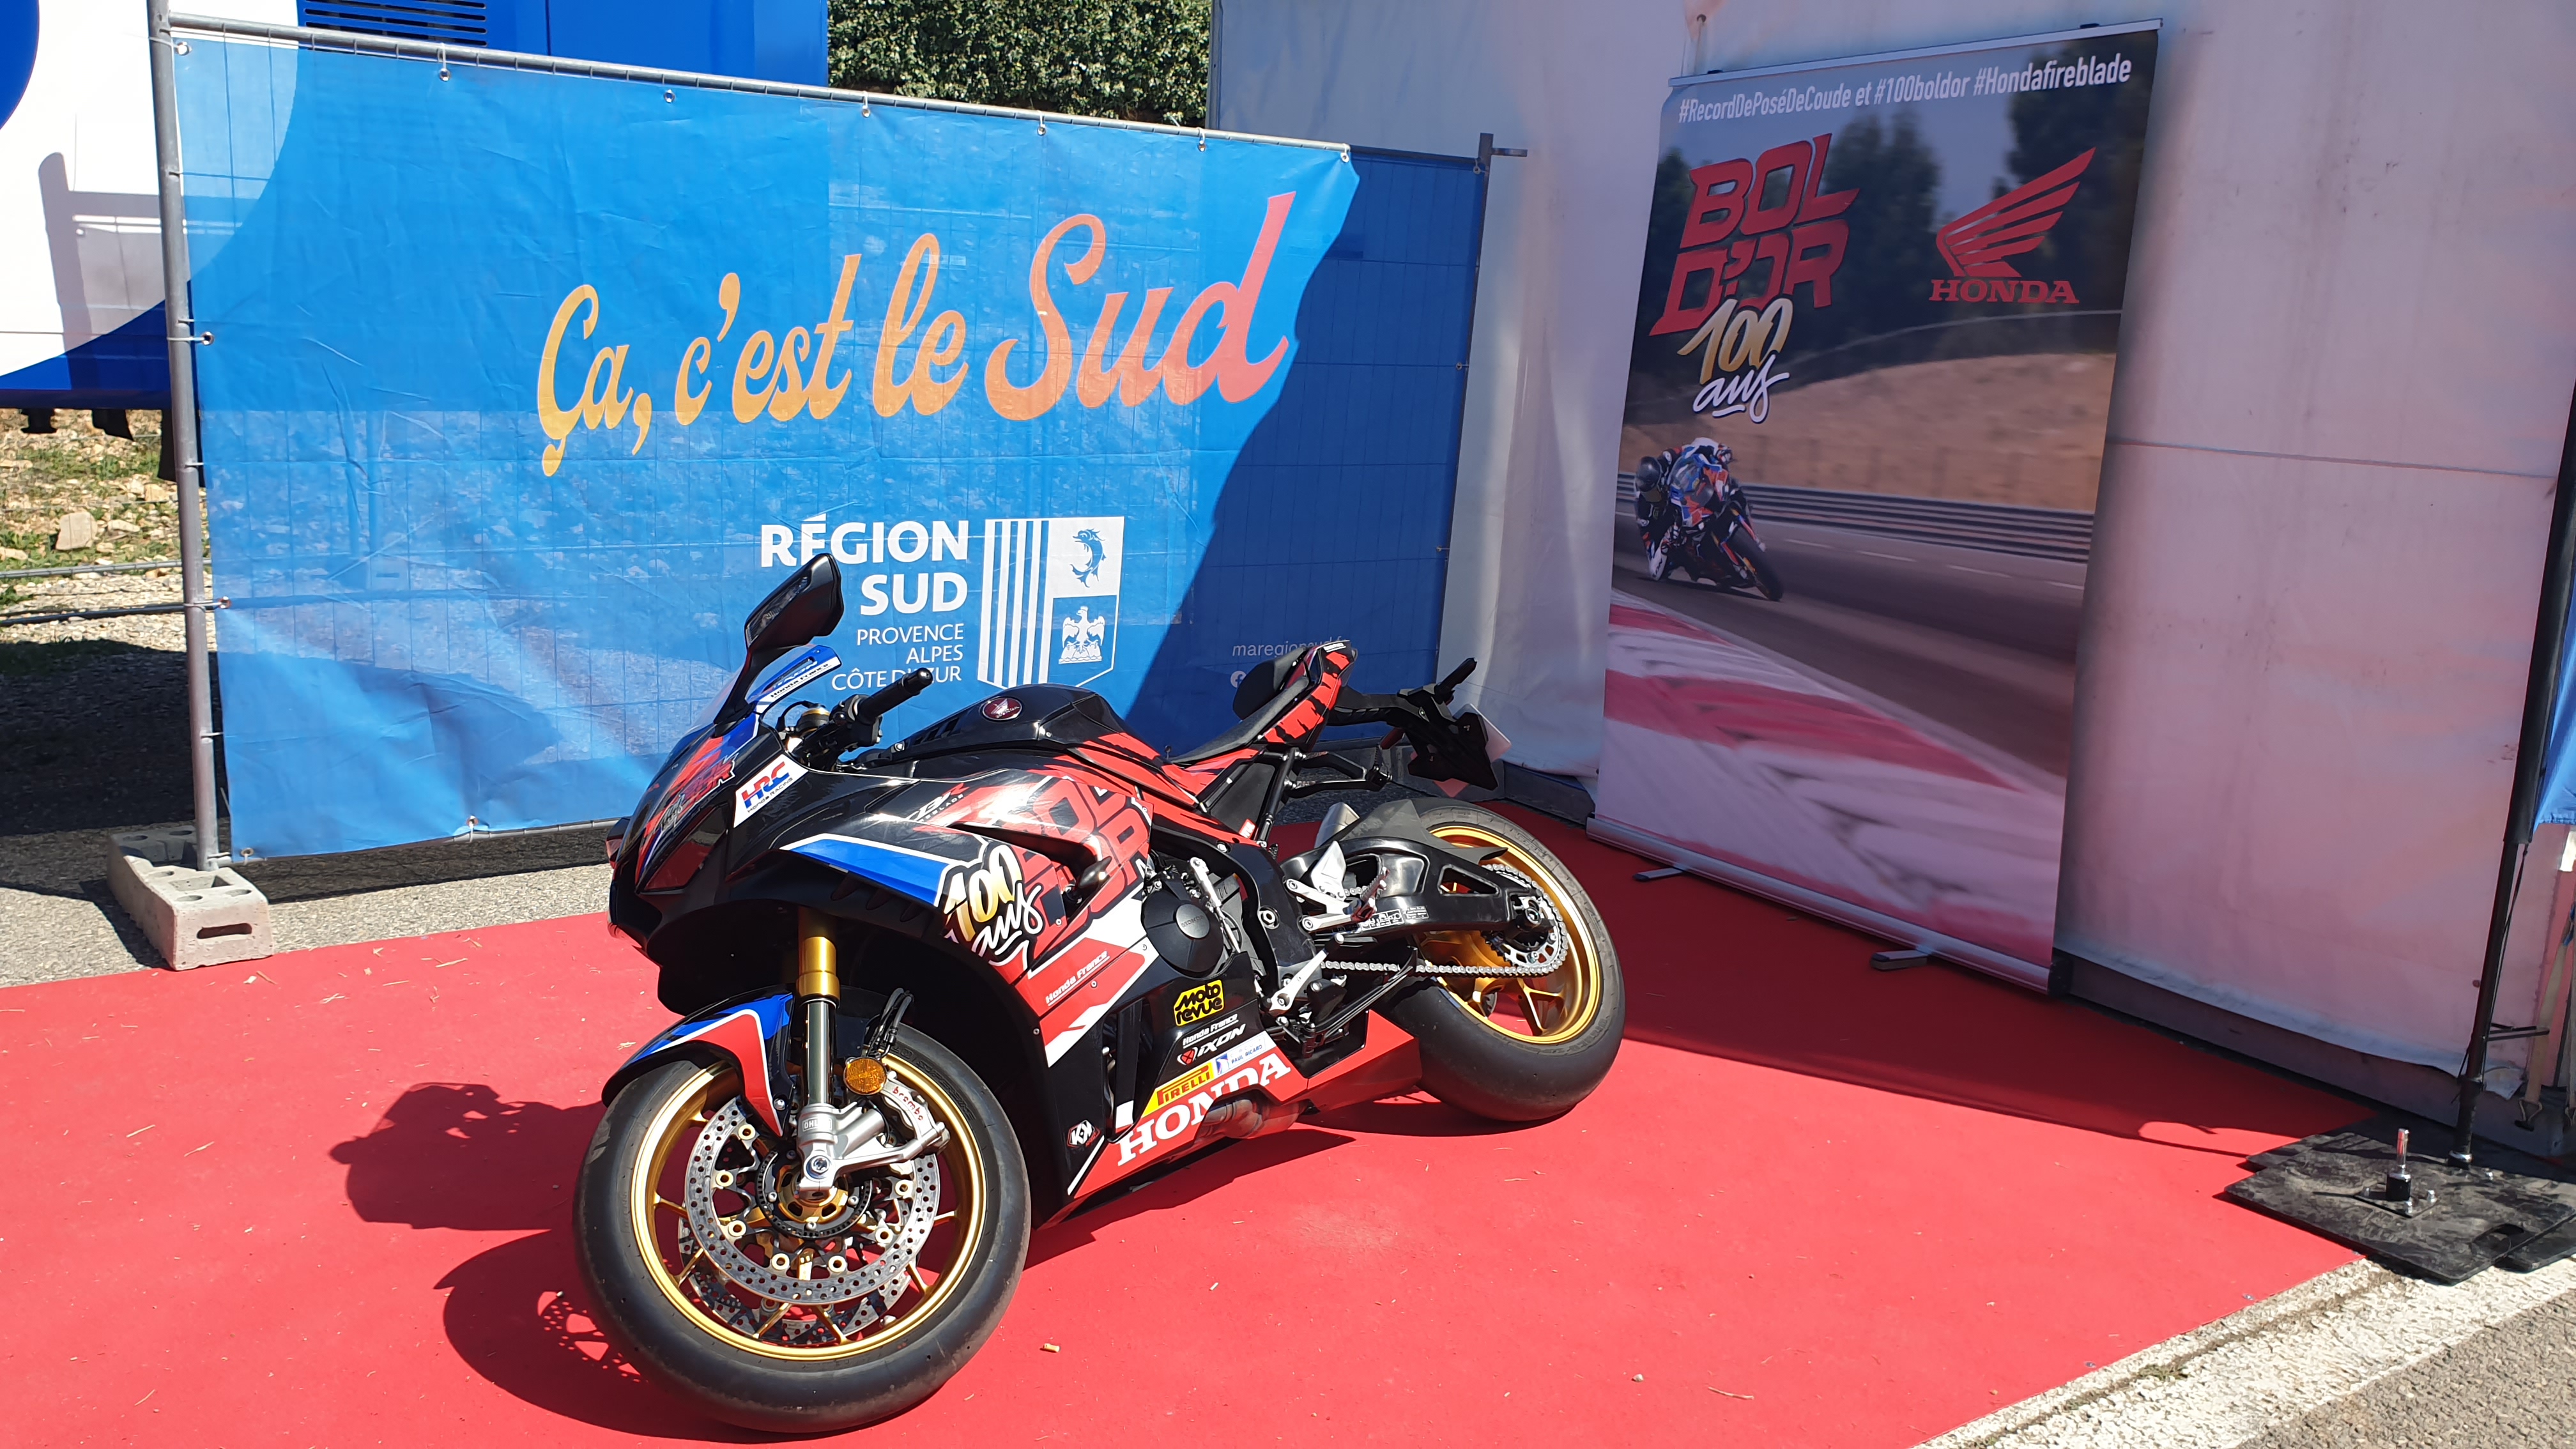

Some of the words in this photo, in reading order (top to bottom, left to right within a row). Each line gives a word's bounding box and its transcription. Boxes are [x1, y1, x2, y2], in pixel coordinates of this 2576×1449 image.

[1678, 83, 1851, 123] #RecordDePoséDeCoude
[1855, 82, 1872, 107] et
[1873, 71, 1971, 106] #100boldor
[1972, 53, 2133, 96] #Hondafireblade
[1680, 133, 1860, 249] BOL
[1929, 279, 2080, 304] HONDA
[537, 284, 652, 477] Ça,
[674, 253, 862, 425] c'est
[872, 233, 969, 418] le
[985, 191, 1296, 421] Sud
[1676, 297, 1793, 385] 100
[1692, 355, 1790, 423] ans
[760, 513, 970, 567] RÉGION
[860, 572, 968, 615] SUD
[856, 623, 964, 645] PROVENCE
[905, 645, 963, 664] ALPES
[831, 667, 887, 691] CÔTE
[741, 761, 790, 809] HRC
[769, 777, 793, 796] RACING
[944, 845, 1023, 942] 100
[1045, 976, 1077, 1004] Honda
[1077, 950, 1108, 979] France
[1182, 1028, 1209, 1046] Honda
[1231, 1055, 1243, 1064] PAUL
[893, 1086, 923, 1121] brembo
[1156, 1064, 1211, 1107] PIRELLI
